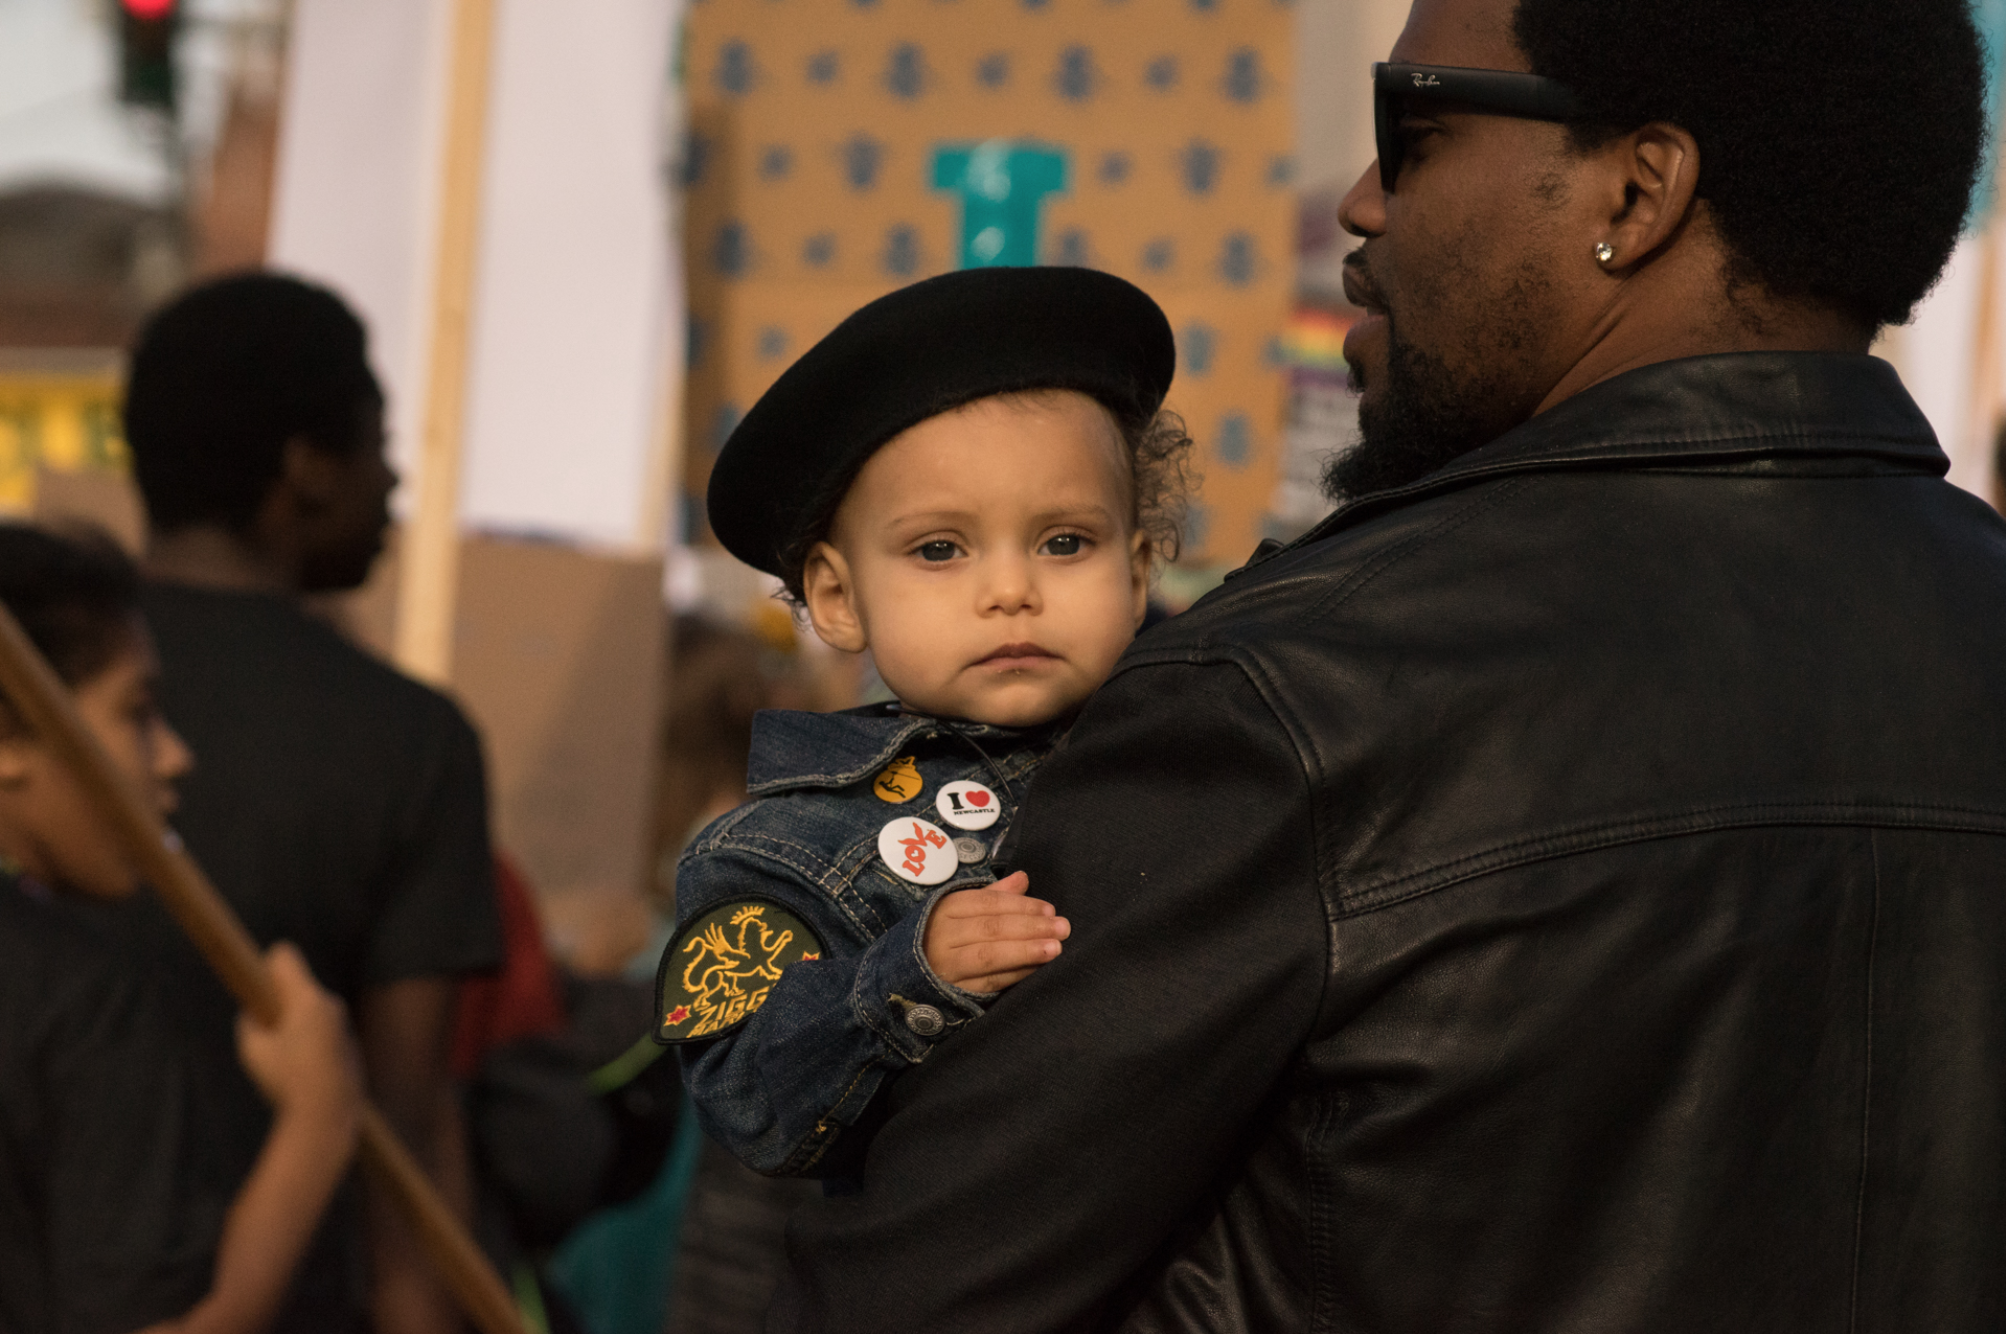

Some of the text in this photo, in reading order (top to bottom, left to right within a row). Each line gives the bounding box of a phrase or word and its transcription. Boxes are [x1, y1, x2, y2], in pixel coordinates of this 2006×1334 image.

[947, 792, 964, 810] I
[898, 821, 948, 877] LOVE
[692, 983, 777, 1030] ZIGG
